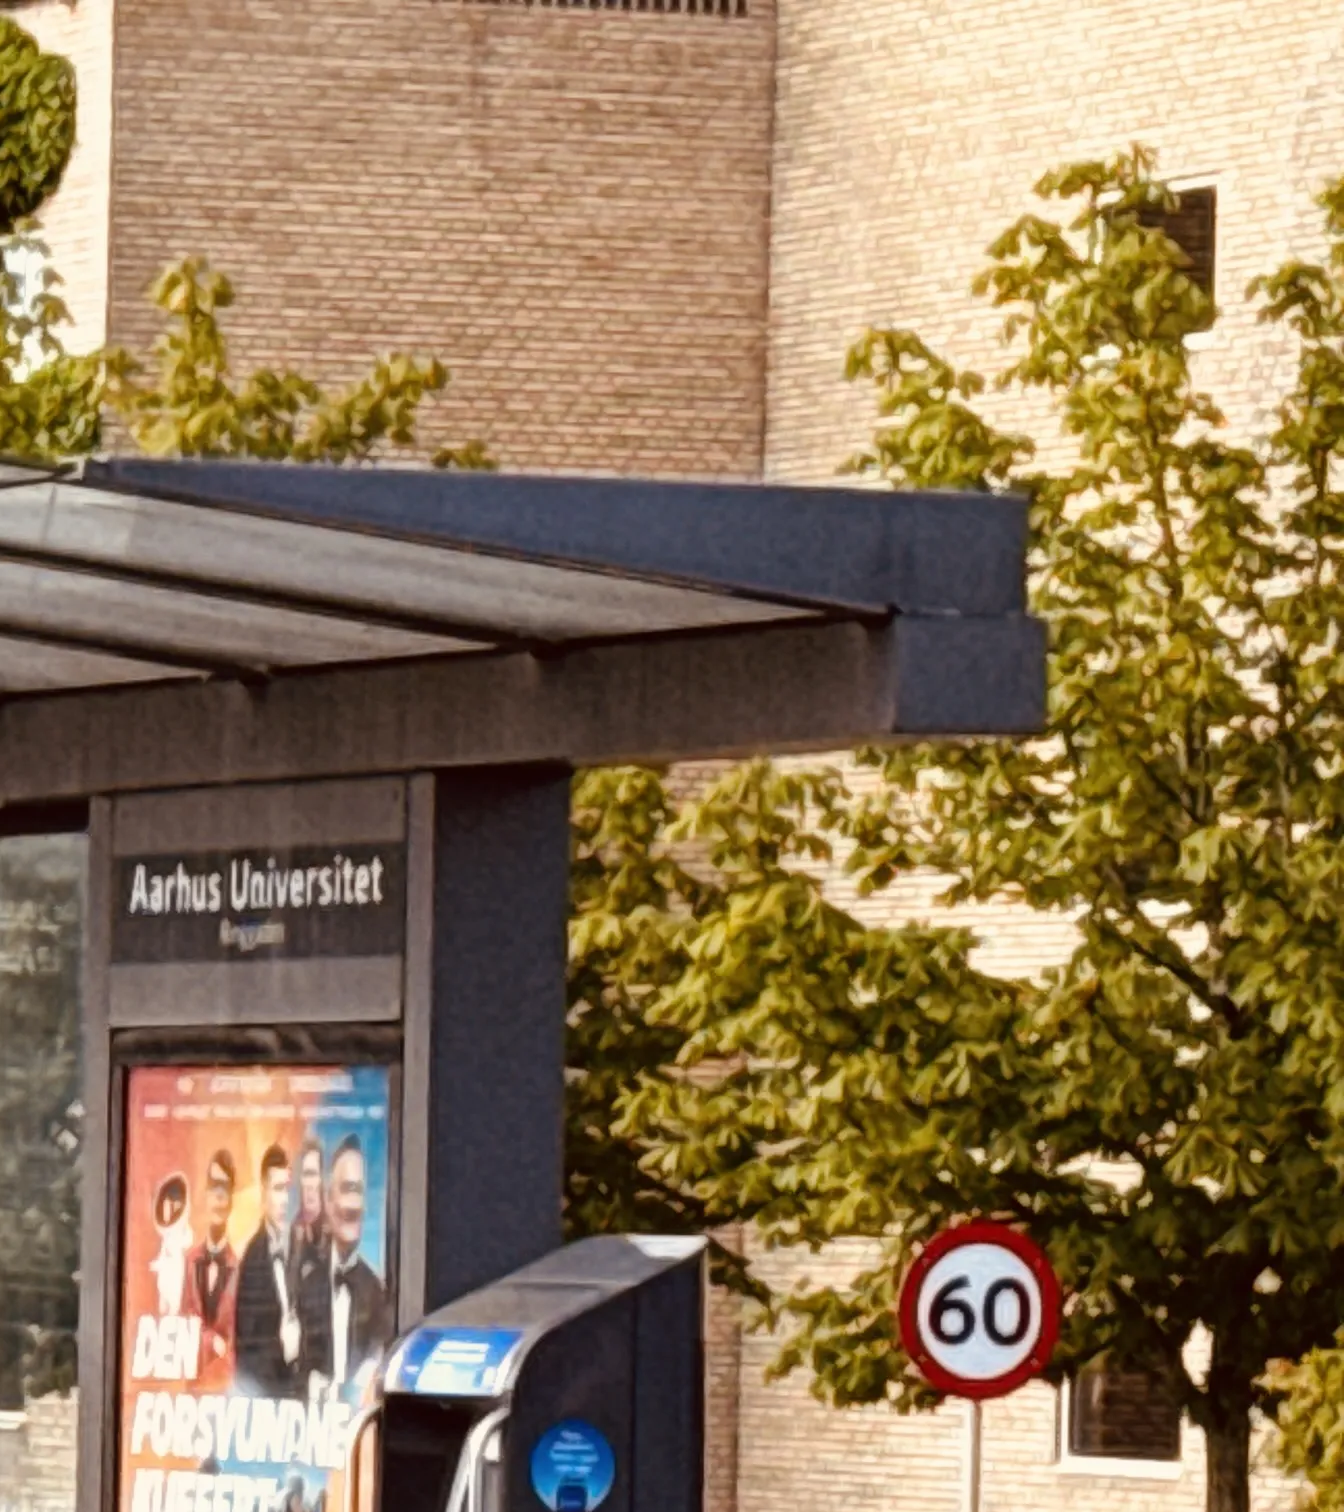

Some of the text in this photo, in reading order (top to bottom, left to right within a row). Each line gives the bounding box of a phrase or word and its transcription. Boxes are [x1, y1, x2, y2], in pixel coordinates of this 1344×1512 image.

[129, 852, 384, 914] Aarhus Universitet
[927, 1274, 1032, 1348] 60
[130, 1314, 202, 1380] DEN
[130, 1391, 351, 1470] FORSVUNDNE
